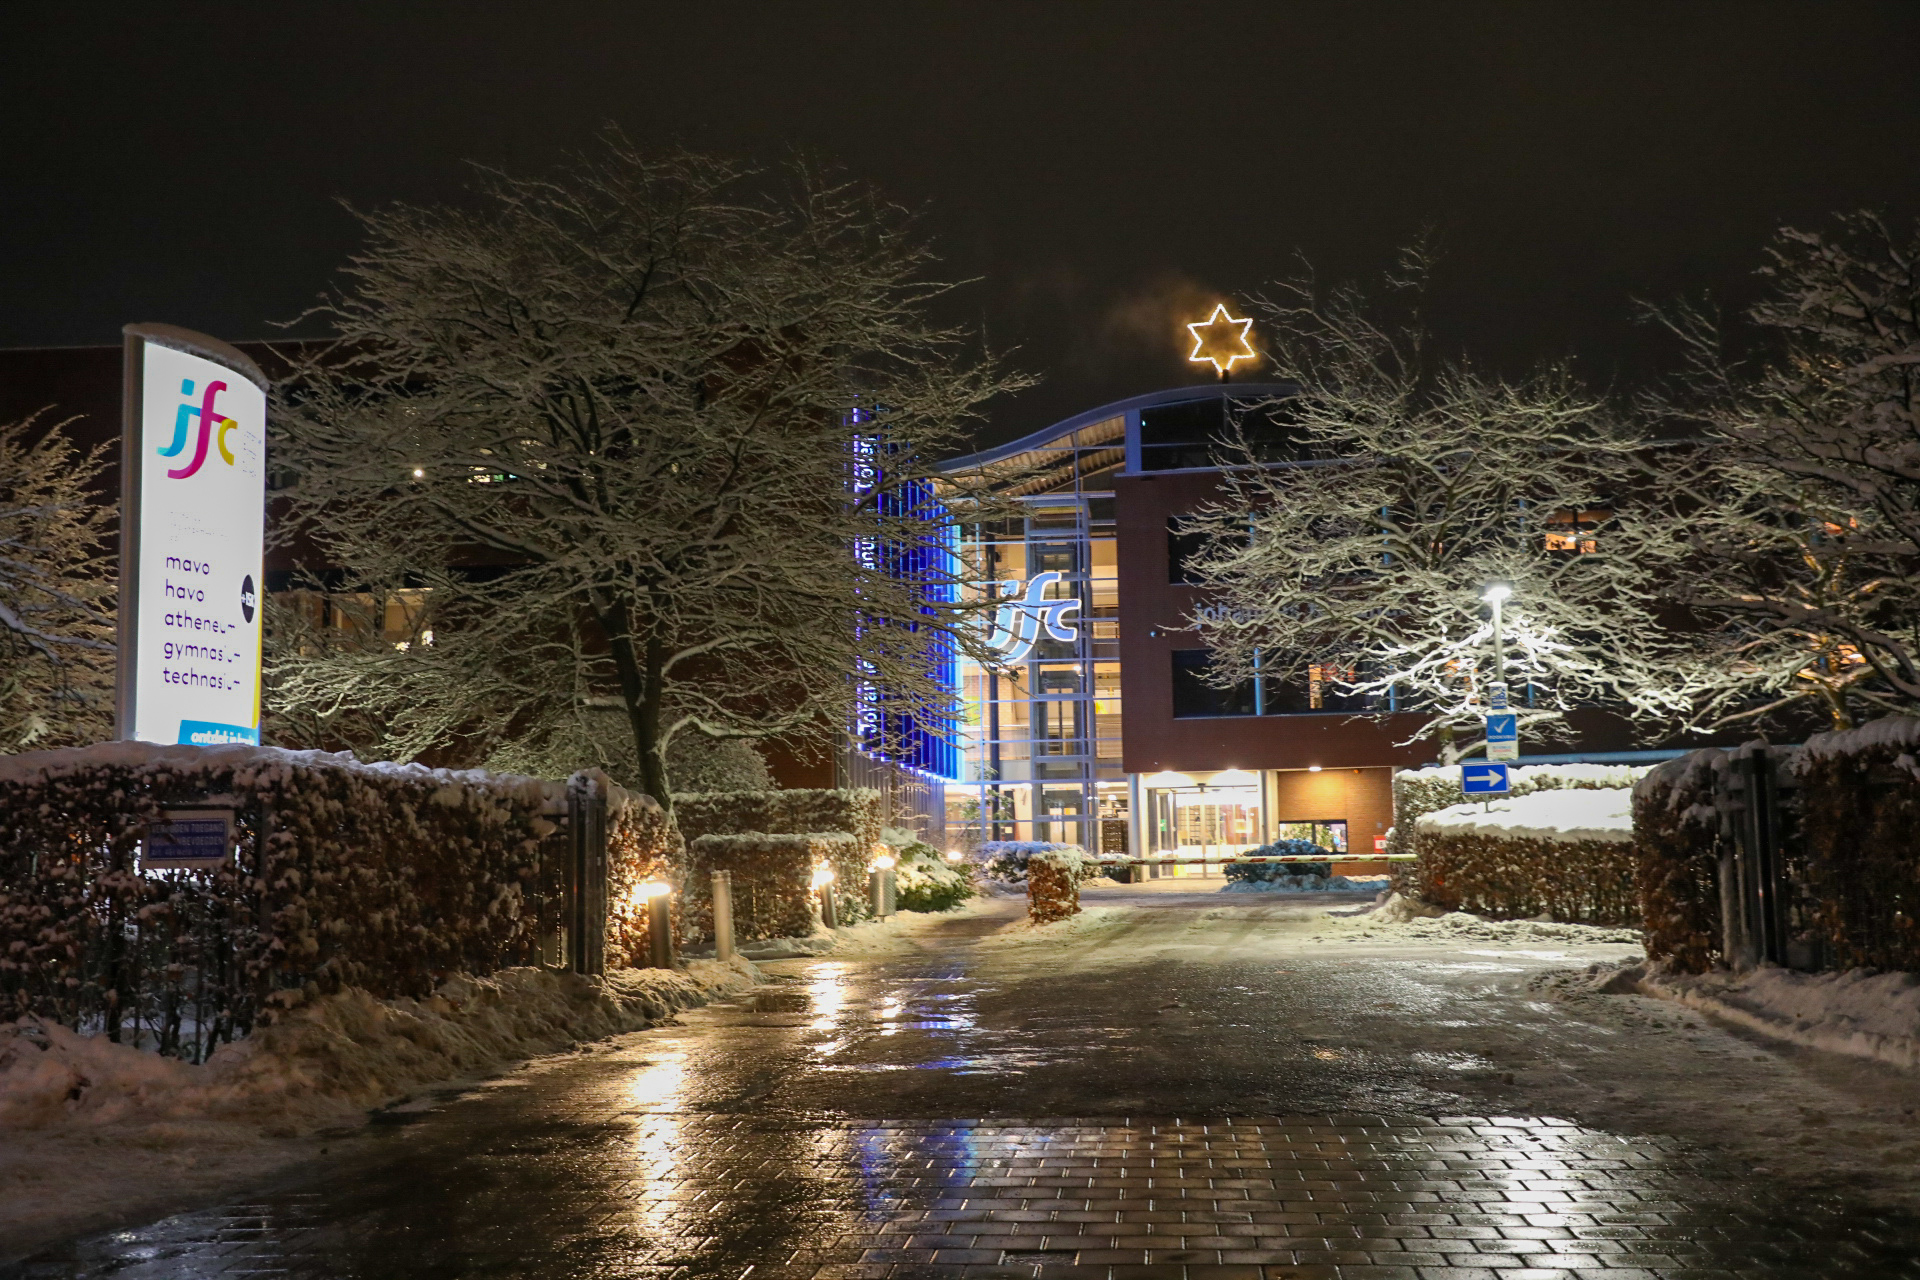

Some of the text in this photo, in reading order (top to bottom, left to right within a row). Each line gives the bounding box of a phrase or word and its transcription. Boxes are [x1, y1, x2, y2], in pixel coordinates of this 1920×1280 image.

[156, 378, 238, 479] jfc
[166, 556, 210, 575] mavo
[165, 578, 205, 602] havo
[983, 572, 1082, 667] jfc
[163, 642, 240, 663] gymnas
